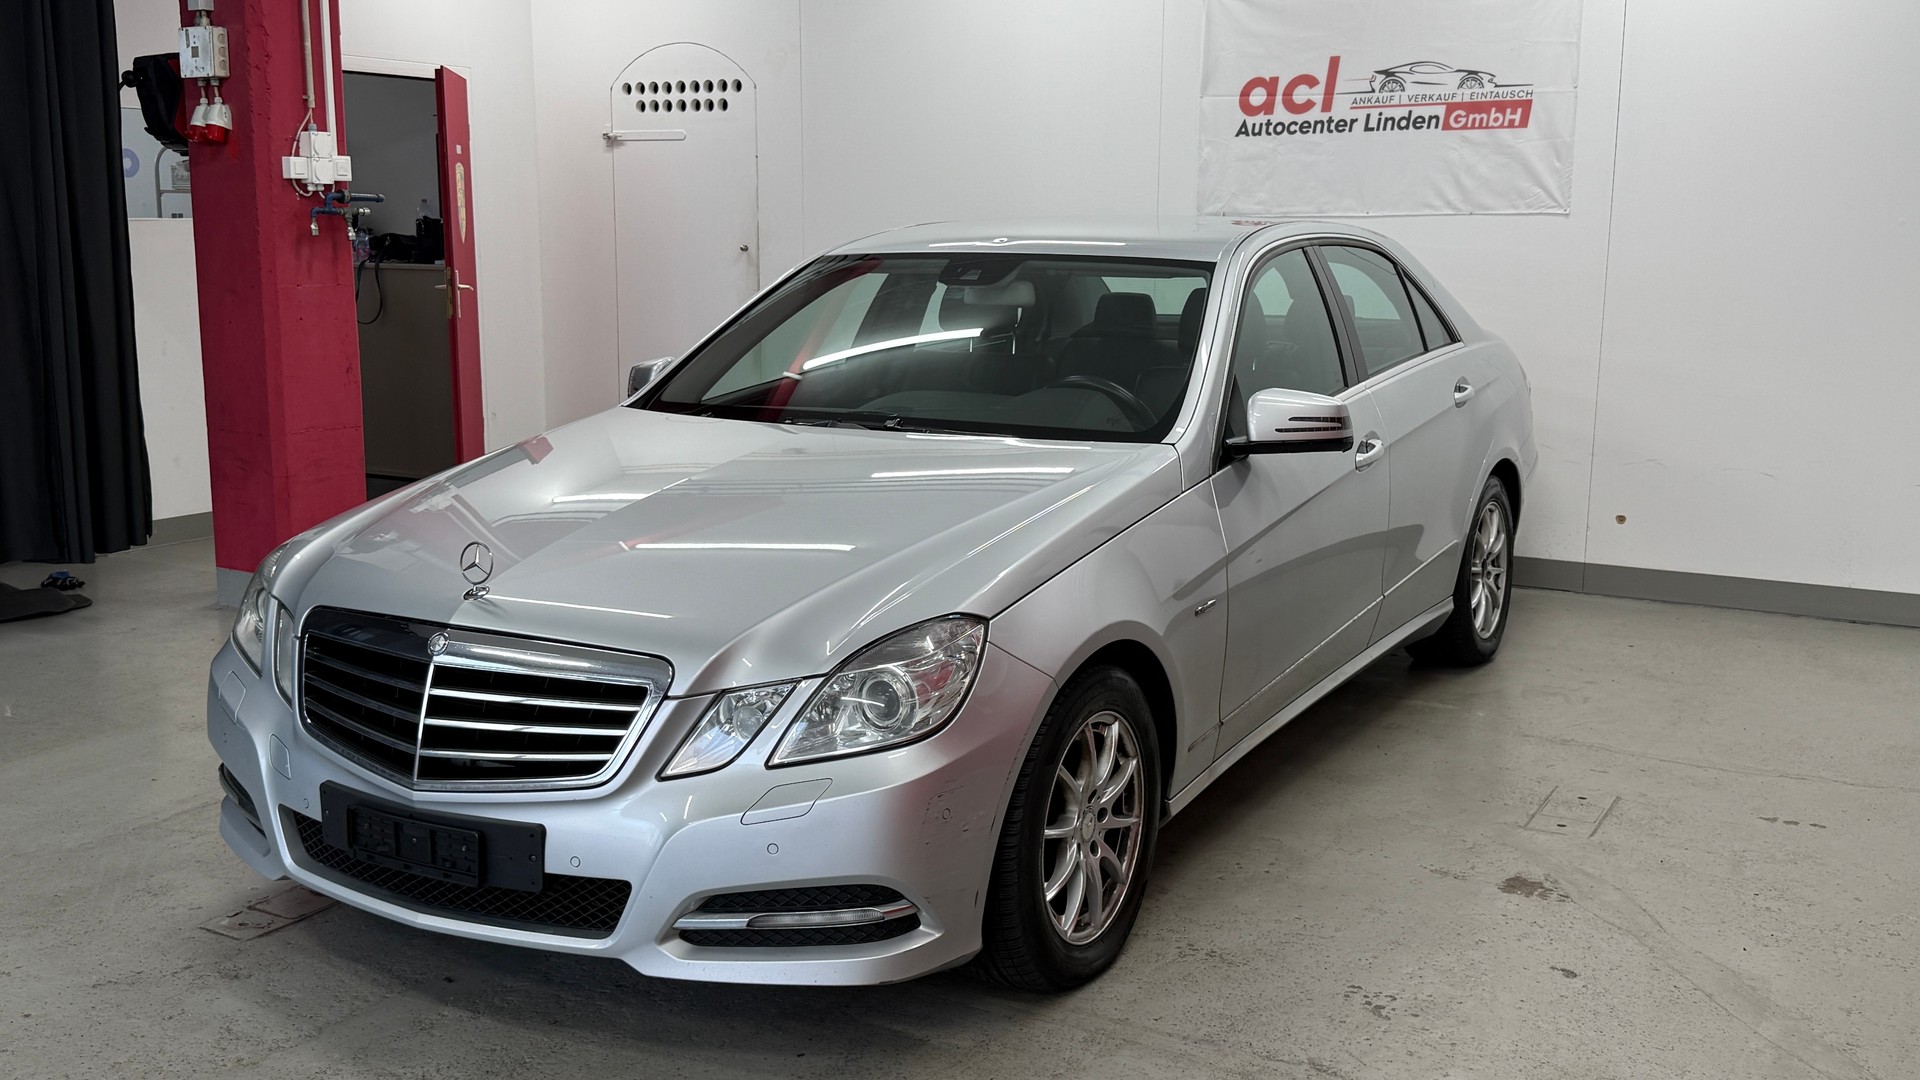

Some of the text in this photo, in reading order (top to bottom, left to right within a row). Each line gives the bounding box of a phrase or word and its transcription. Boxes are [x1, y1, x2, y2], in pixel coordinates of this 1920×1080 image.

[1238, 55, 1341, 117] acl
[1351, 89, 1534, 106] ANKAUF VERKAUF EINTAUSCH
[1235, 107, 1523, 137] Autocenter Linden GmbH
